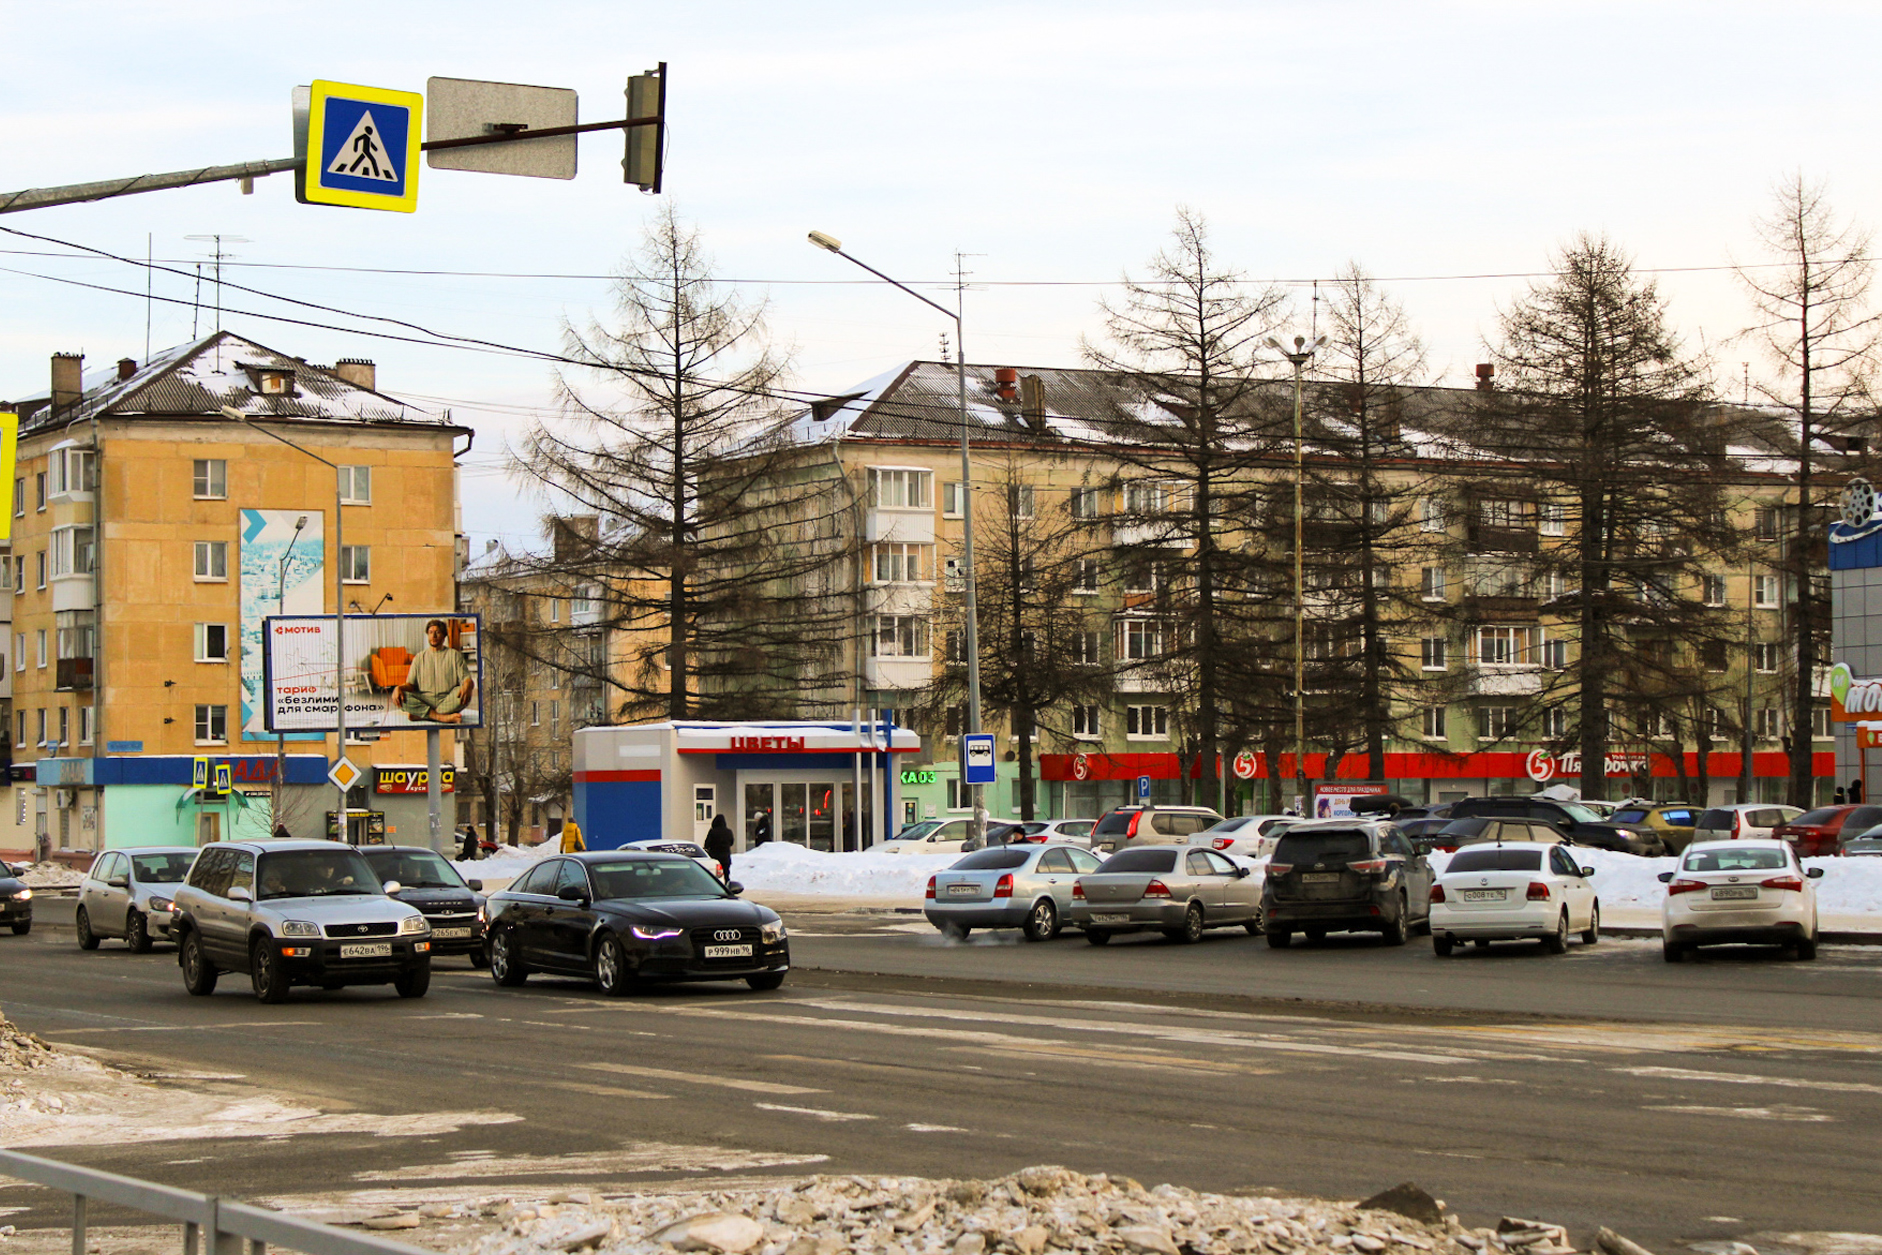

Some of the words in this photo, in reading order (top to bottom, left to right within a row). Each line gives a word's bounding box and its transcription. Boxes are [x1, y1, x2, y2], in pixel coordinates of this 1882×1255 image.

[277, 686, 317, 694] тариф
[277, 695, 342, 704] «безлими
[277, 706, 301, 715] для
[304, 704, 385, 714] смарфона»
[731, 736, 804, 750] ЦВЕТЫ
[380, 771, 454, 790] шаура
